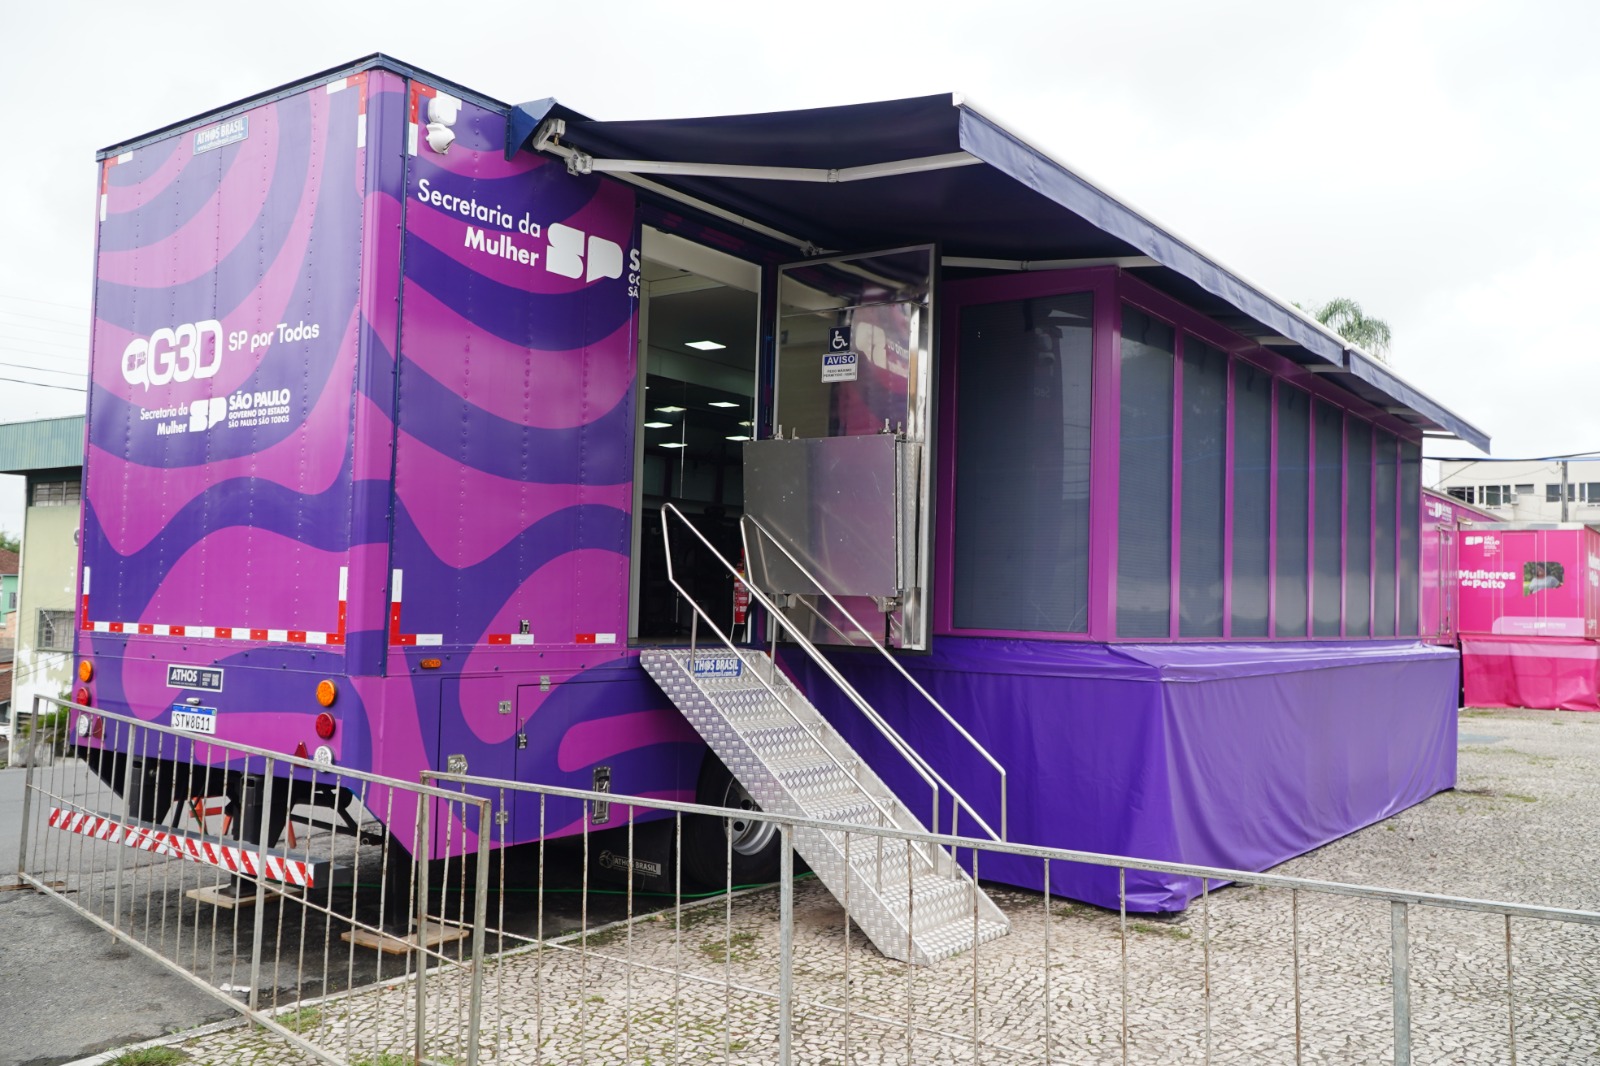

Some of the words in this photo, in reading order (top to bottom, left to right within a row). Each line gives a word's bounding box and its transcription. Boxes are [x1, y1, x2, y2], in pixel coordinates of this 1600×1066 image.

[197, 126, 220, 145] ATHOS
[221, 118, 244, 137] BRASIL
[417, 178, 513, 229] Secretaria
[518, 212, 541, 238] da
[464, 226, 539, 267] Mulher
[229, 330, 248, 351] SP
[251, 331, 274, 353] por
[277, 320, 319, 344] Todas
[827, 356, 855, 364] AVISO
[229, 390, 252, 410] SÃO
[254, 388, 290, 407] PAULO
[140, 404, 178, 420] Secretaria
[178, 402, 188, 416] da
[228, 409, 257, 419] GOVERNO
[257, 408, 267, 417] DO
[267, 405, 290, 416] ESTADO
[156, 420, 188, 436] Mulher
[228, 419, 239, 428] SÃO
[240, 418, 258, 427] PAULO
[258, 415, 270, 425] SÃO
[270, 414, 290, 424] TODOS
[1459, 569, 1516, 580] Mulheres
[1462, 579, 1473, 587] de
[1472, 579, 1506, 589] Peito
[693, 660, 715, 671] THOS
[715, 659, 739, 670] BRASIL
[171, 669, 197, 682] ATHOS
[175, 714, 210, 731] STW8G11
[635, 861, 657, 872] BRASIL
